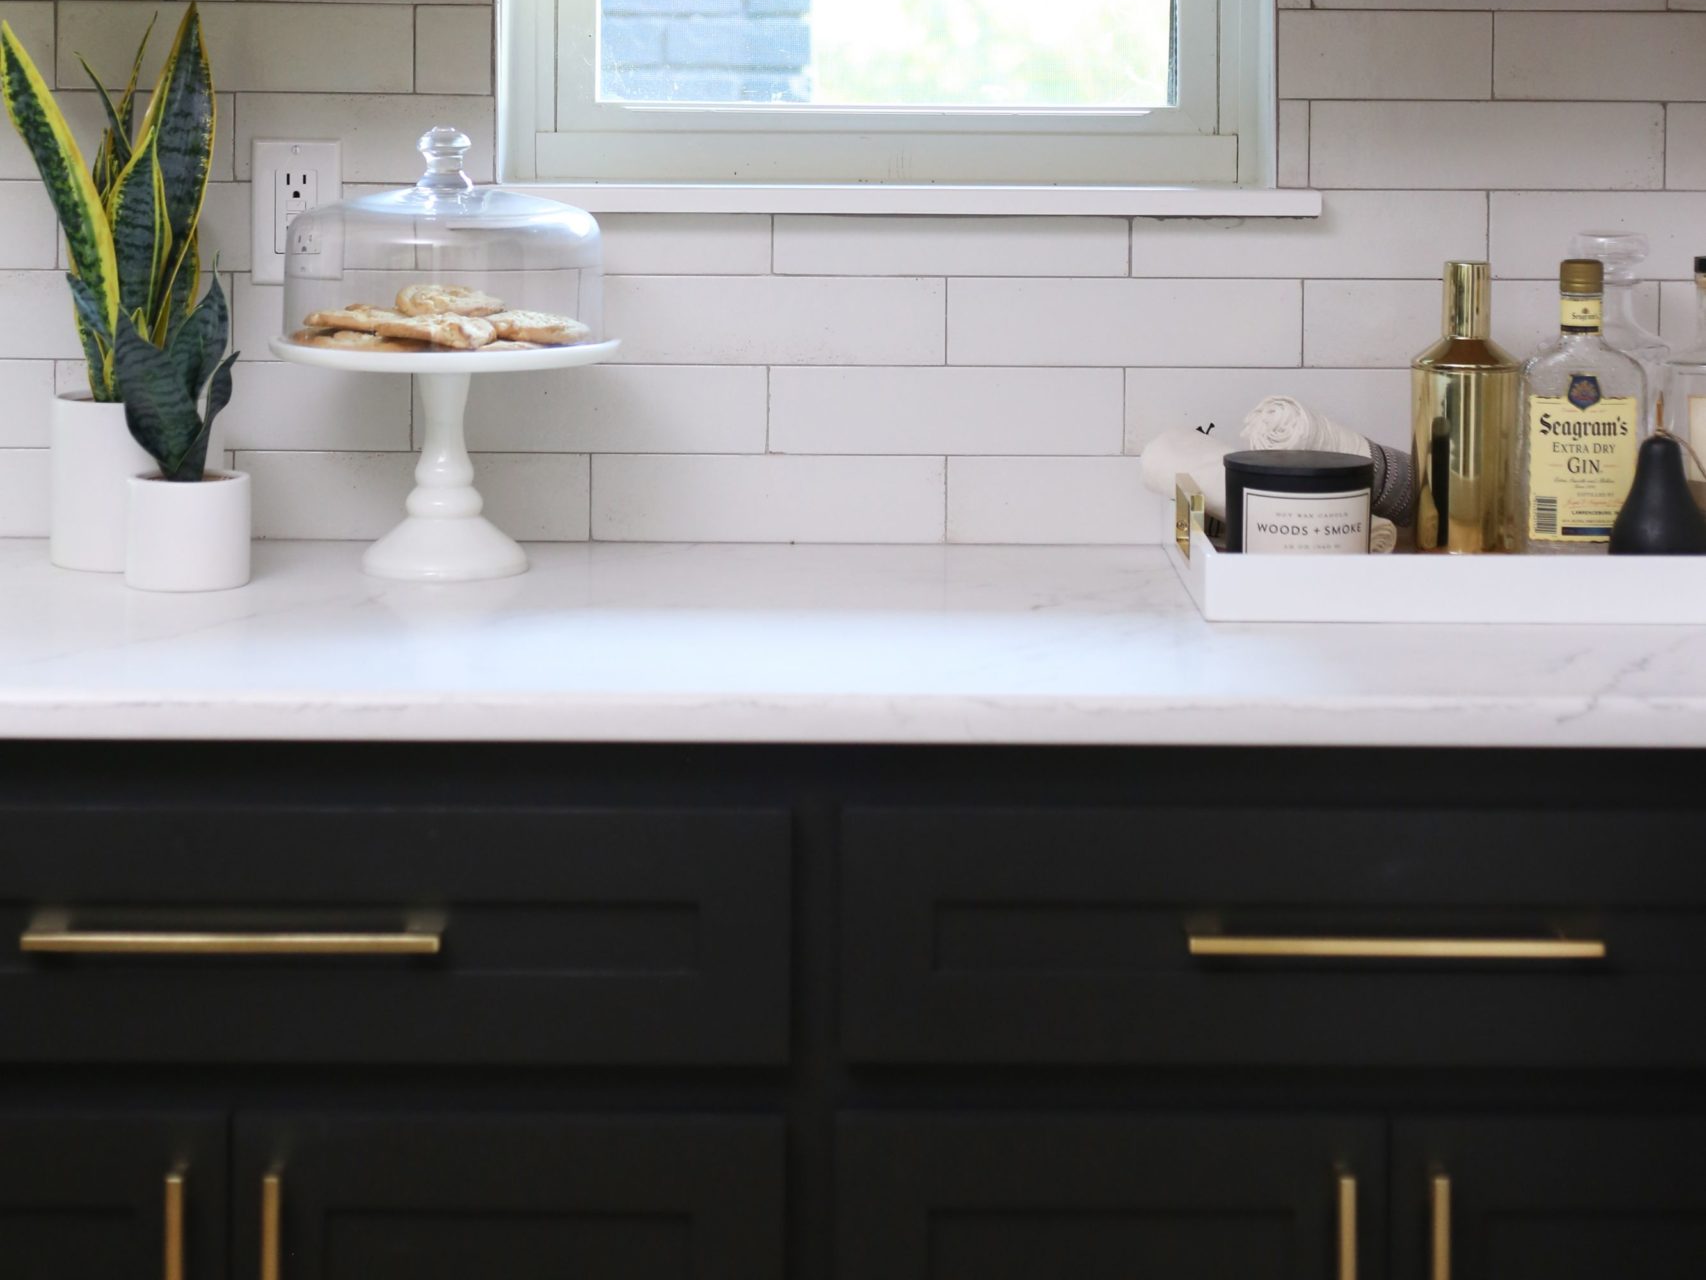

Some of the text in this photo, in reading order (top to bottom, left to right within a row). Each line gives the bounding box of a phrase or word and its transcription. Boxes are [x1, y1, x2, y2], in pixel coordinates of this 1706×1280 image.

[1539, 412, 1628, 441] Seagram's
[1552, 441, 1616, 454] EXTRA DRY
[1567, 457, 1601, 474] GIN
[1257, 523, 1309, 536] WOODS
[1324, 522, 1362, 536] SMOKE
